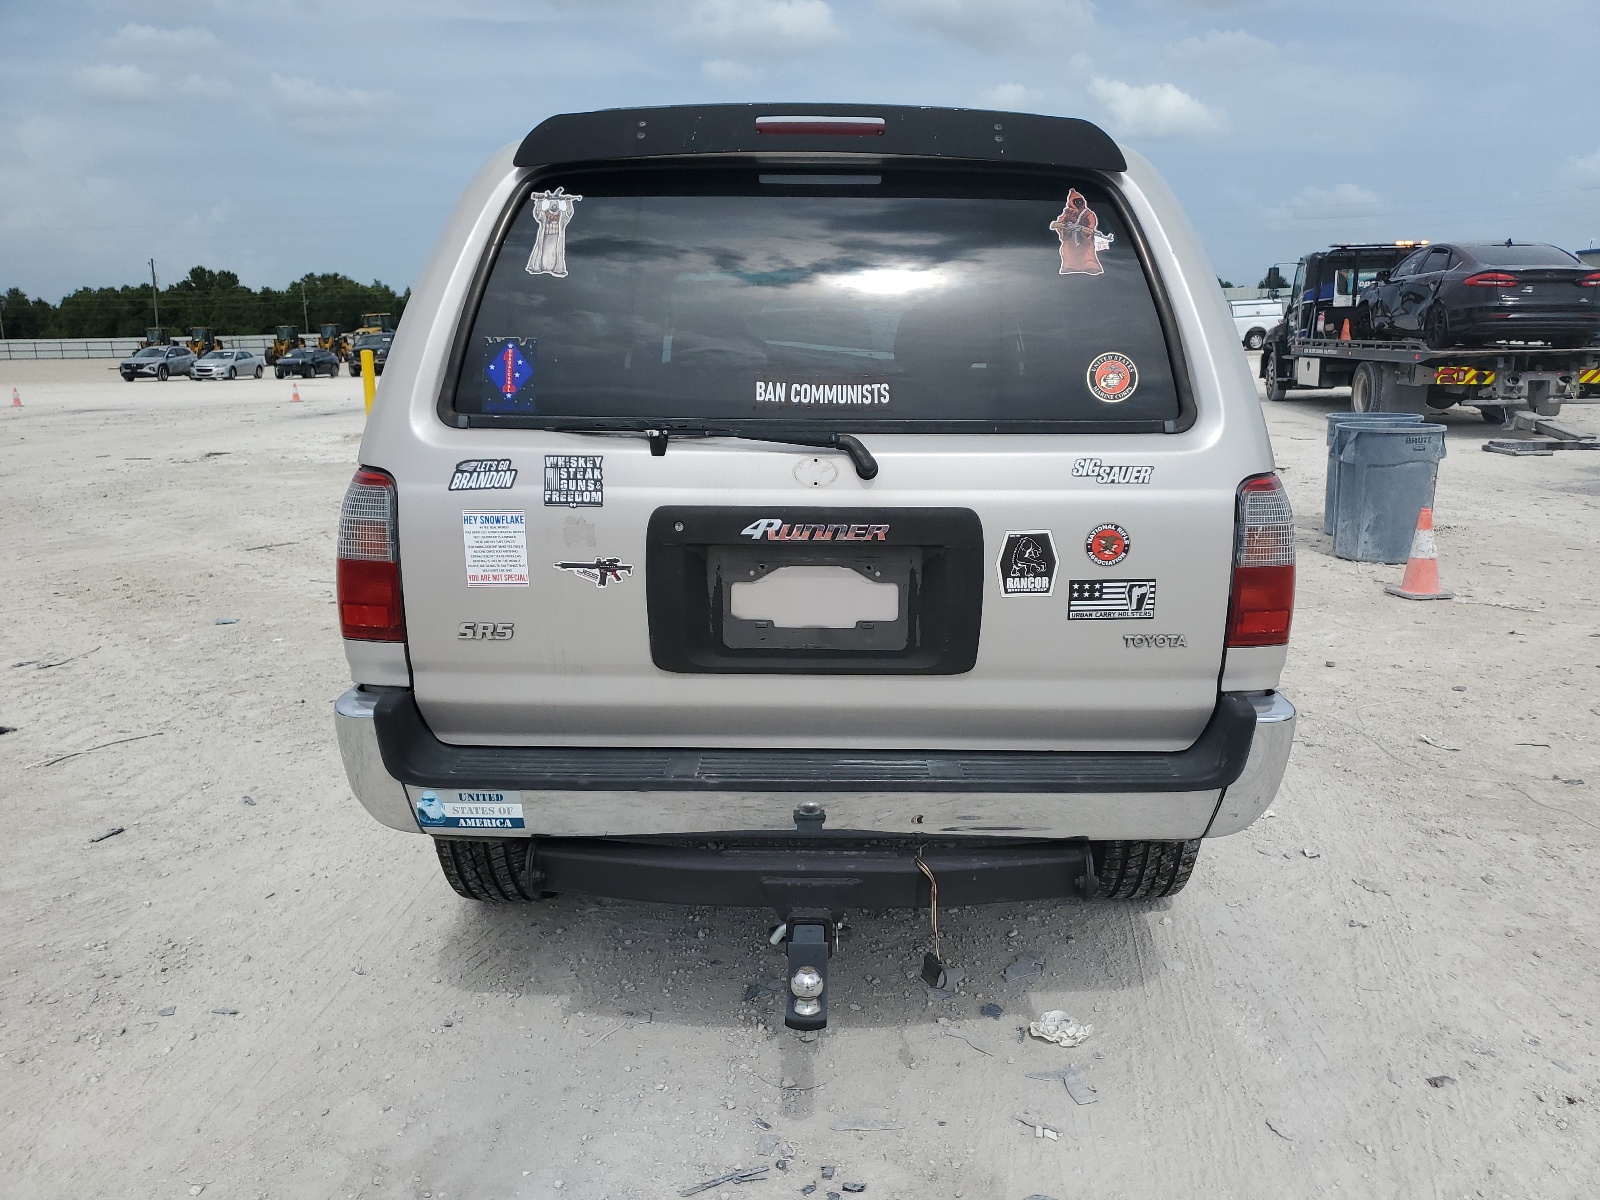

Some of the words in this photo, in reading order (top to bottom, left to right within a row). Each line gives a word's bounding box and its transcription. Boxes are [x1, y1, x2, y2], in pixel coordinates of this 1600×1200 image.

[1091, 355, 1113, 372] UNITED
[1114, 355, 1135, 373] STATES
[756, 381, 787, 402] BAN
[790, 383, 890, 404] COMMUNISTS
[1092, 385, 1115, 400] MARINE
[1114, 386, 1133, 400] CORPS
[476, 460, 498, 472] LET'S
[497, 460, 510, 471] GO
[545, 456, 602, 468] WHISKEY
[1072, 458, 1101, 477] SIG
[560, 467, 602, 479] STEAK
[1097, 466, 1152, 484] SAUER
[450, 470, 516, 490] BRANDON
[560, 479, 595, 491] GUNS
[544, 490, 602, 503] FREEDOM
[463, 515, 478, 525] HEY
[479, 515, 525, 525] SNOWFLAKE
[1086, 524, 1116, 544] NATIONAL
[1116, 526, 1130, 545] RIFLE
[1087, 551, 1127, 566] ASSOCIATION
[468, 574, 480, 582] YOU
[480, 574, 491, 582] ARE
[491, 574, 503, 582] NOT
[503, 573, 529, 582] SPECIAL!
[1006, 577, 1050, 589] RANCOR
[457, 621, 514, 641] SR5
[1123, 633, 1187, 649] TOYOTA
[458, 792, 504, 802] UNITED
[452, 806, 496, 815] STATES
[498, 806, 514, 815] OF
[458, 818, 513, 828] AMERICA
